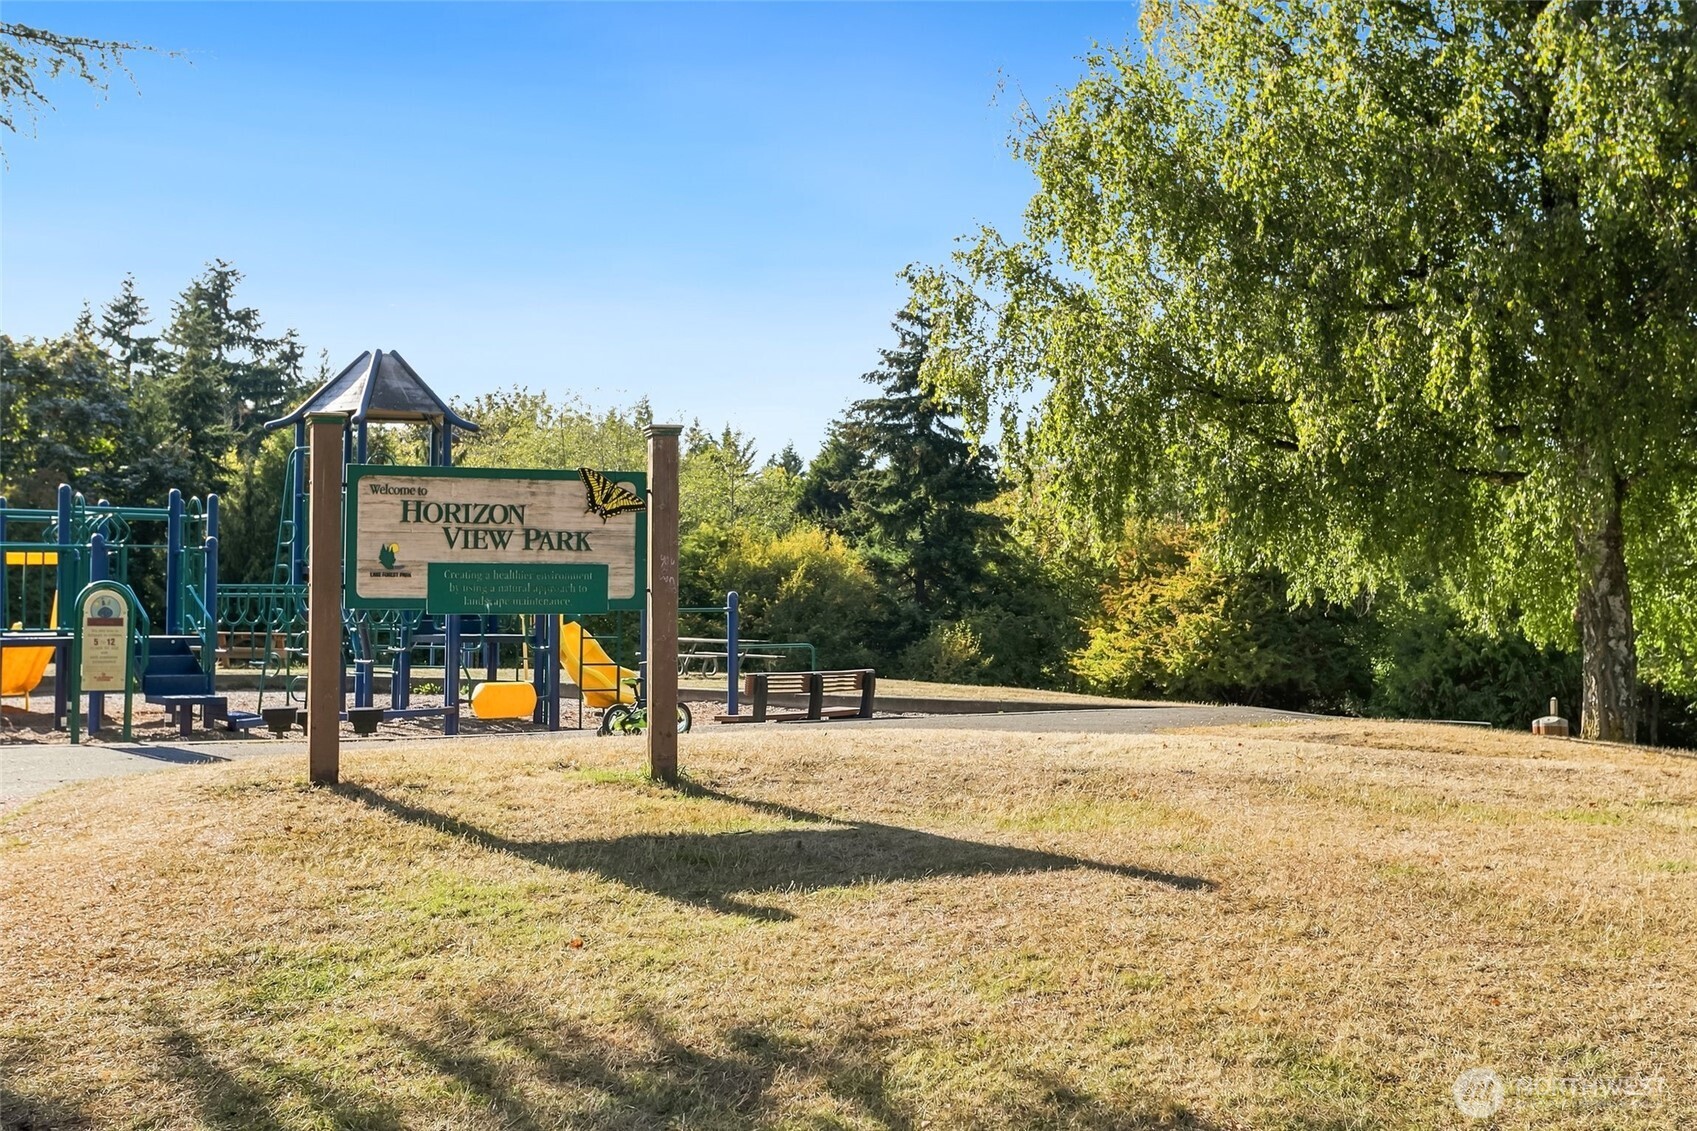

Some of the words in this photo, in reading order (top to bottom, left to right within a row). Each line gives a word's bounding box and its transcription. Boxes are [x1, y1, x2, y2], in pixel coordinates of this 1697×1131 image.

[369, 484, 416, 496] Welcome
[417, 486, 428, 496] to
[400, 499, 526, 525] HORIZON
[442, 526, 514, 550] VIEW
[522, 528, 593, 552] PARK
[444, 569, 483, 582] Creating
[485, 572, 490, 580] a
[493, 569, 532, 580] healthier
[536, 570, 593, 580] environment
[449, 582, 459, 595] by
[463, 584, 488, 595] using
[490, 585, 495, 593] a
[498, 582, 531, 593] natural
[578, 584, 588, 593] to
